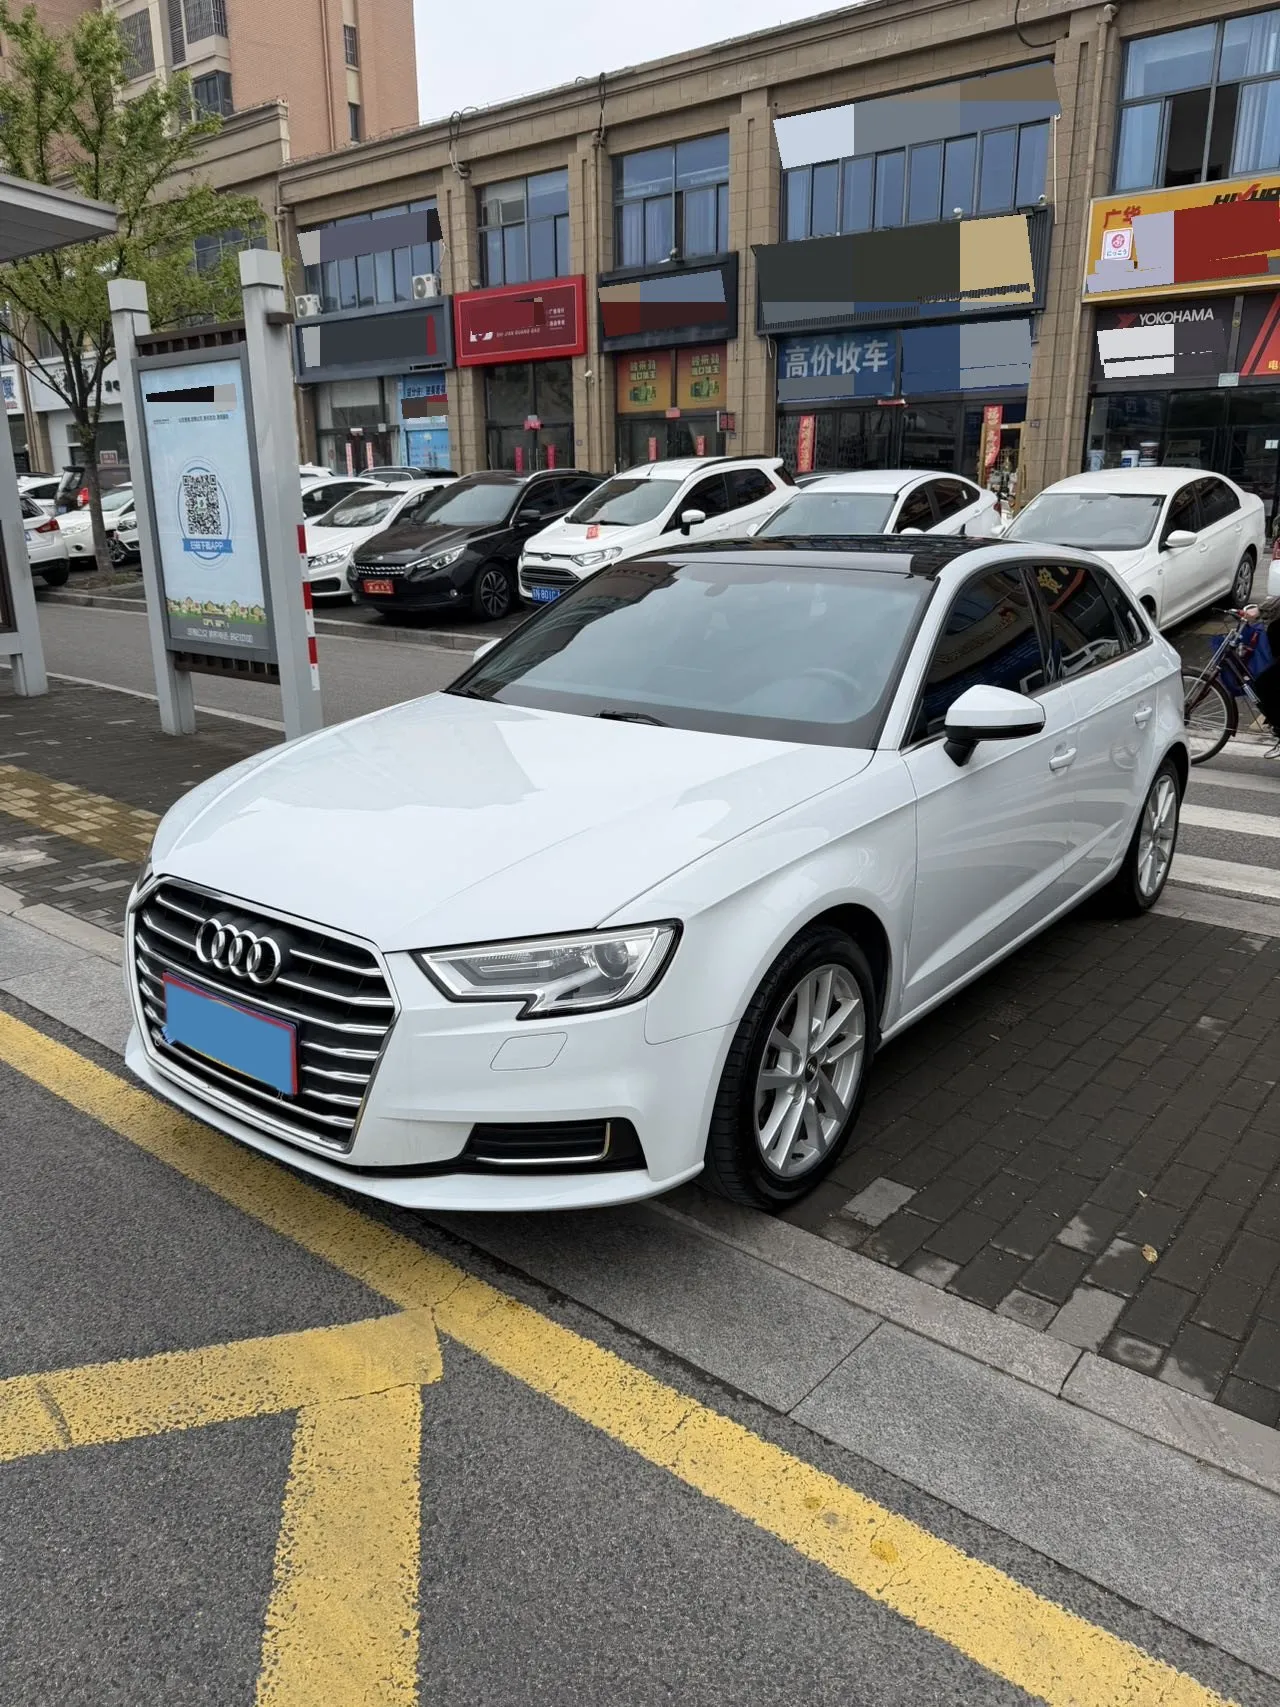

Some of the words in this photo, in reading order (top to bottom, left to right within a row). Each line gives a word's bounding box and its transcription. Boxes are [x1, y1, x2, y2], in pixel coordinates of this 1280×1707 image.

[1139, 307, 1215, 326] YOKOHAMA
[785, 339, 889, 378] 高价收车
